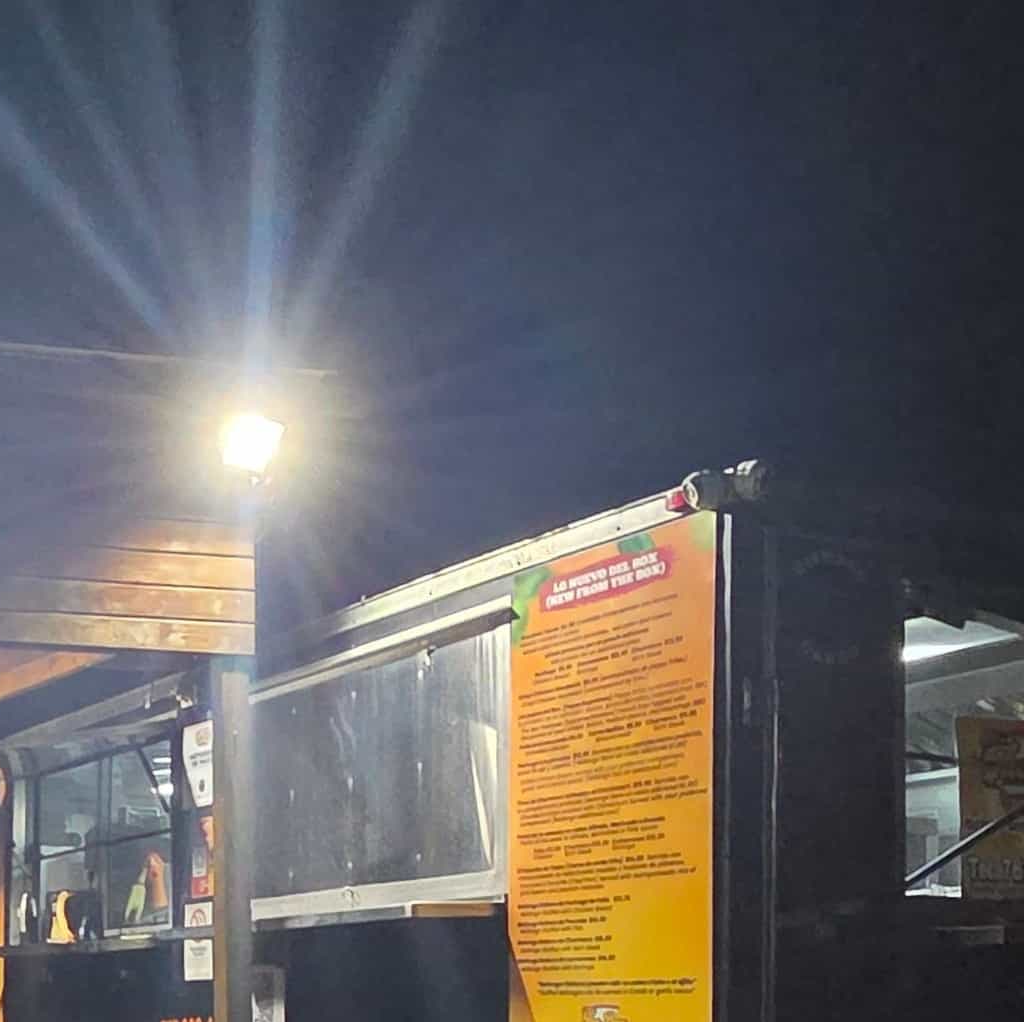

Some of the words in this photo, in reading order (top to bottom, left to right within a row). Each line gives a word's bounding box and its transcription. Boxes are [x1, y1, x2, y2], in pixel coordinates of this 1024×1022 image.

[568, 568, 607, 589] NUEVO
[608, 561, 631, 577] DEL
[632, 552, 658, 569] BOX
[575, 579, 609, 599] FROM
[610, 572, 634, 588] THE
